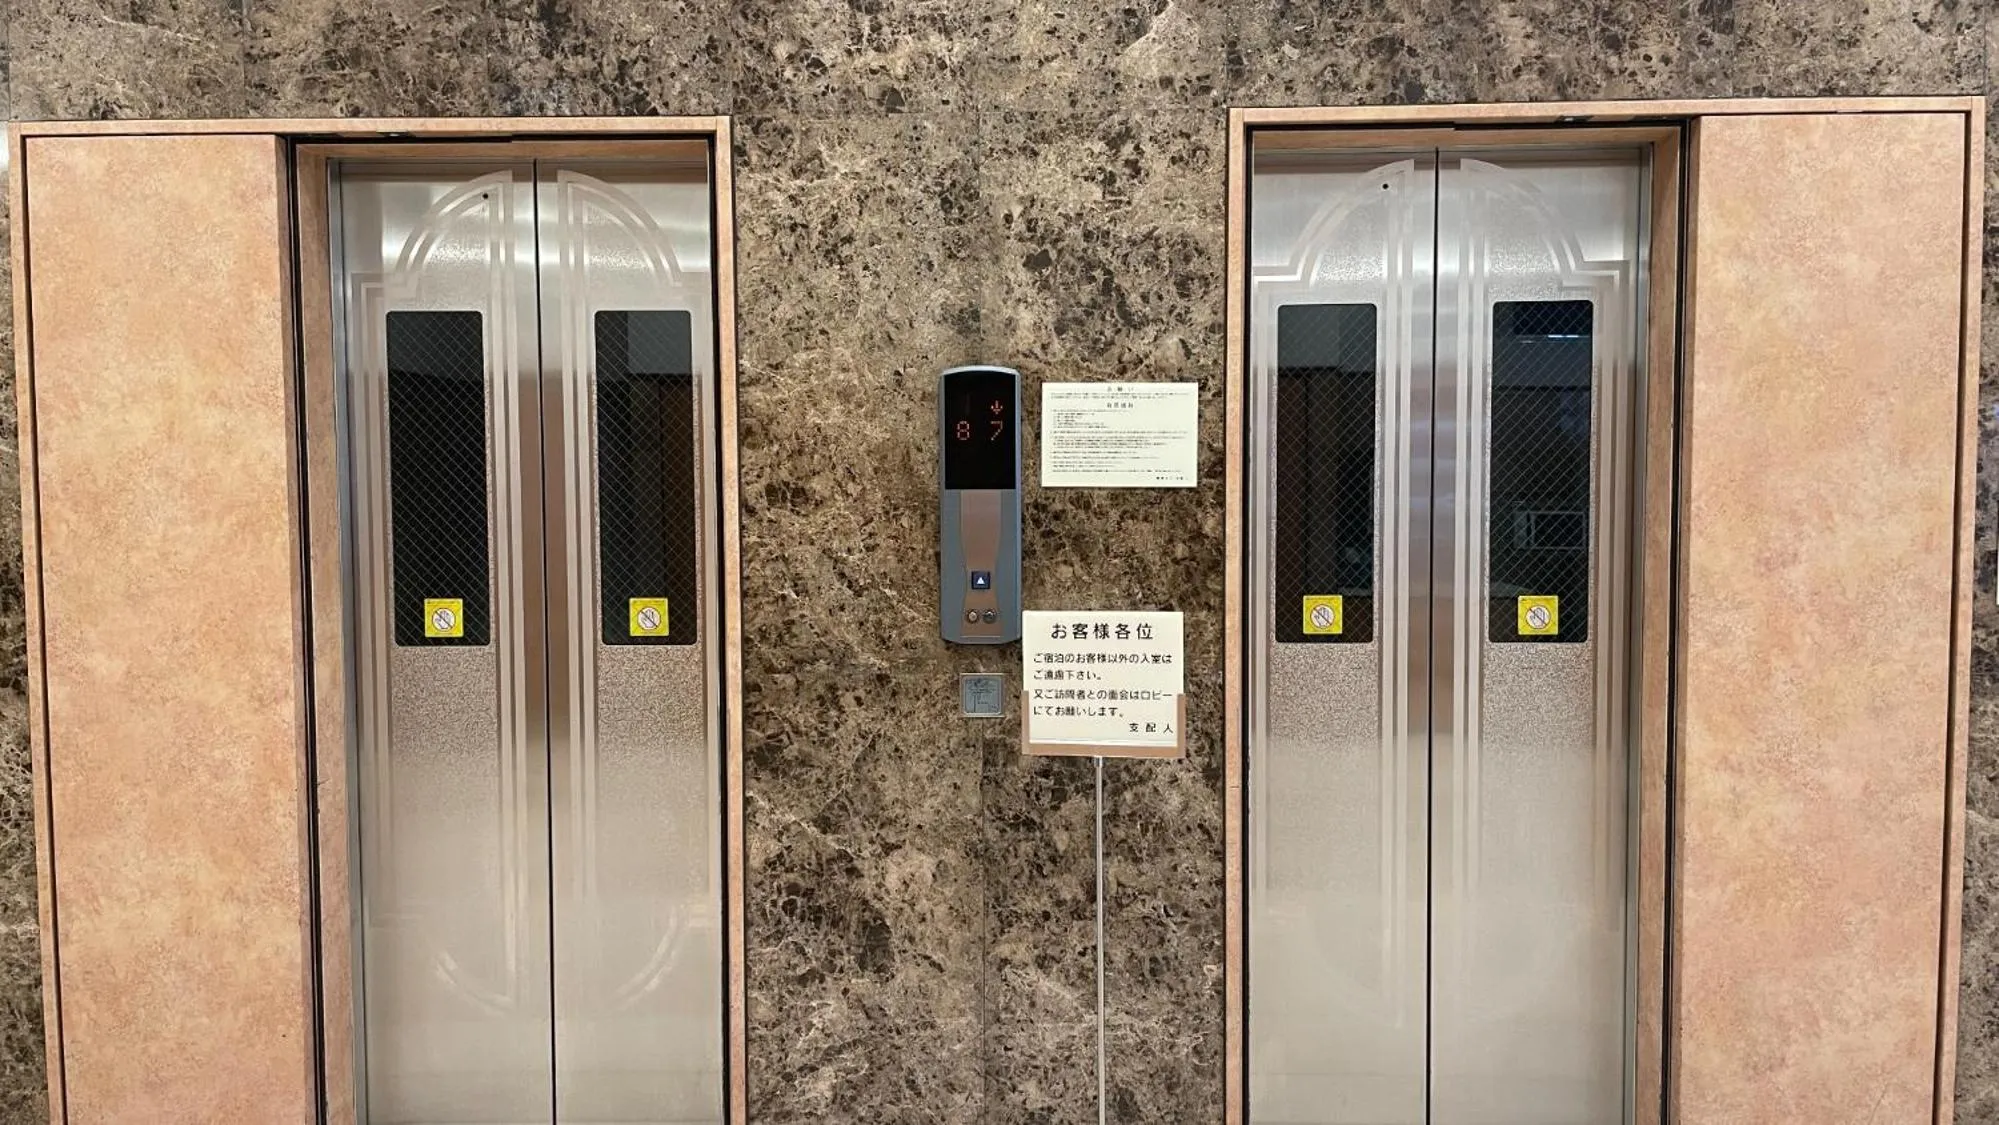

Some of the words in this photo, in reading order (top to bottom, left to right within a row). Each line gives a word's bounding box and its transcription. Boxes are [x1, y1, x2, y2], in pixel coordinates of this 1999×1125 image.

[956, 420, 970, 441] 8
[990, 420, 1004, 441] 7
[1050, 622, 1153, 640] お客様各位
[1033, 652, 1173, 665] ご宿泊のお客様以外の入室は
[1033, 669, 1102, 681] ご遠慮下さい。
[1033, 705, 1124, 718] にてお願いします。
[1128, 722, 1174, 734] 支配人
